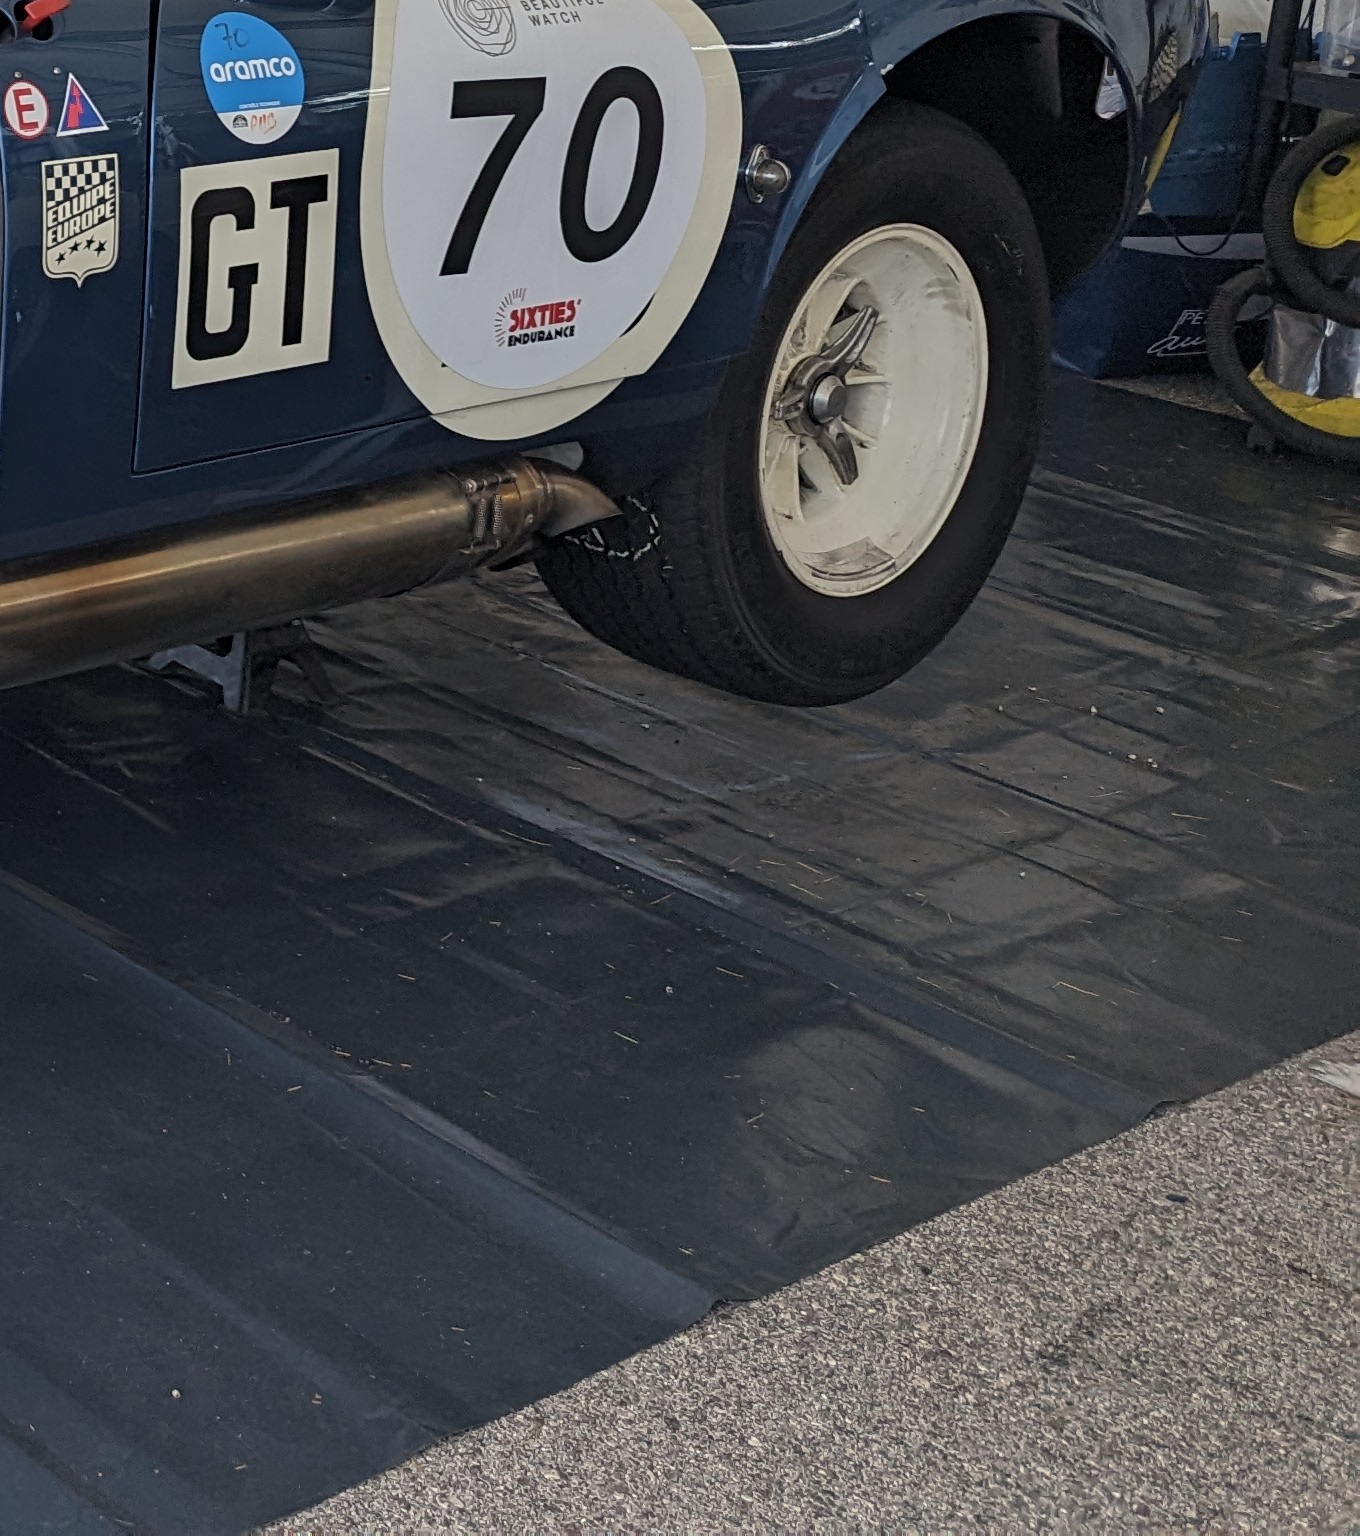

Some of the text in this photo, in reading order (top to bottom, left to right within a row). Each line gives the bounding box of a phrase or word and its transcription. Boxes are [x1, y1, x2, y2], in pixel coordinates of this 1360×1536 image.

[215, 22, 250, 50] 70
[528, 11, 582, 26] WATCH
[210, 56, 296, 83] aramco
[12, 87, 39, 131] E
[438, 65, 665, 276] 70
[47, 178, 115, 228] EQUIPE
[47, 198, 115, 249] EUROPE
[186, 174, 328, 362] GT
[507, 325, 576, 347] ENDURANCE
